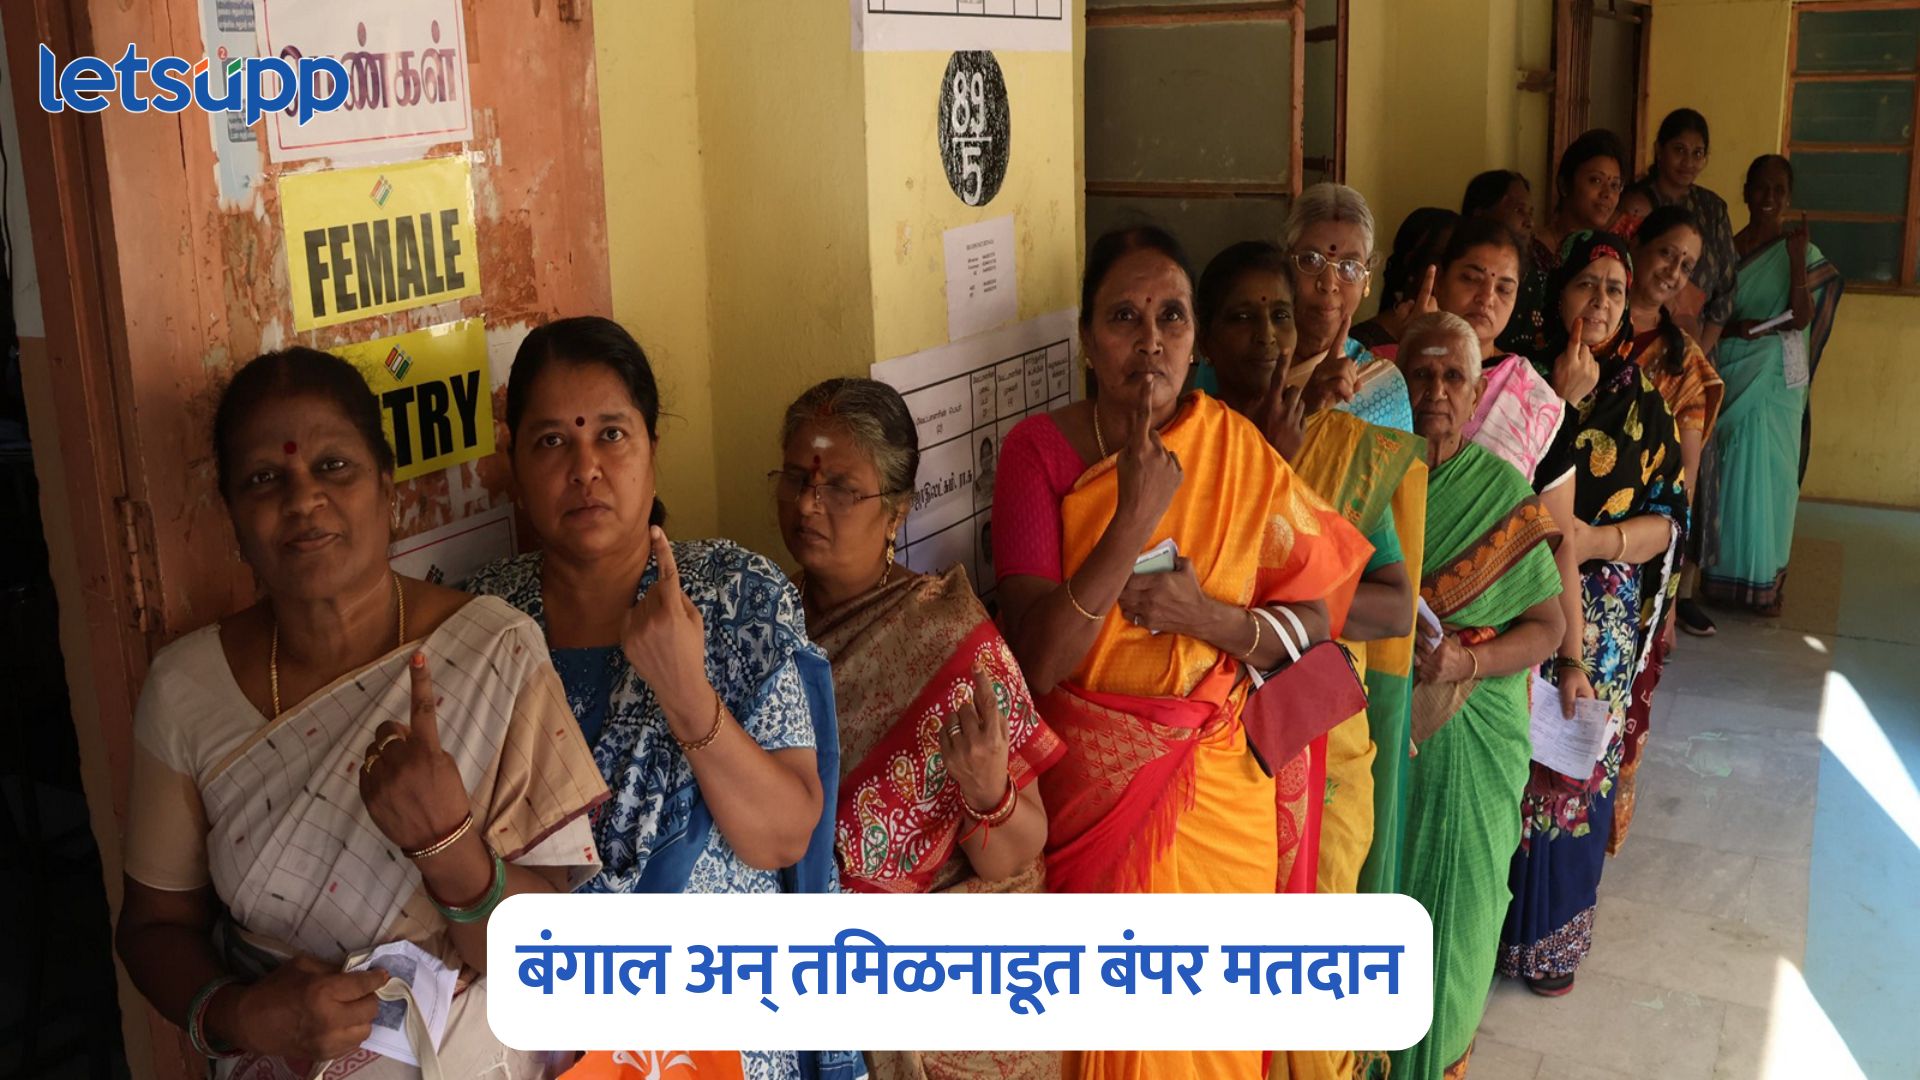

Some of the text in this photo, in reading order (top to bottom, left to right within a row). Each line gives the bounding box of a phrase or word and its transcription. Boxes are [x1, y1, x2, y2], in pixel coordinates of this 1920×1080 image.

[952, 71, 985, 137] 89
[962, 147, 982, 206] 5
[304, 208, 465, 318] FEMALE
[377, 369, 481, 469] TRY
